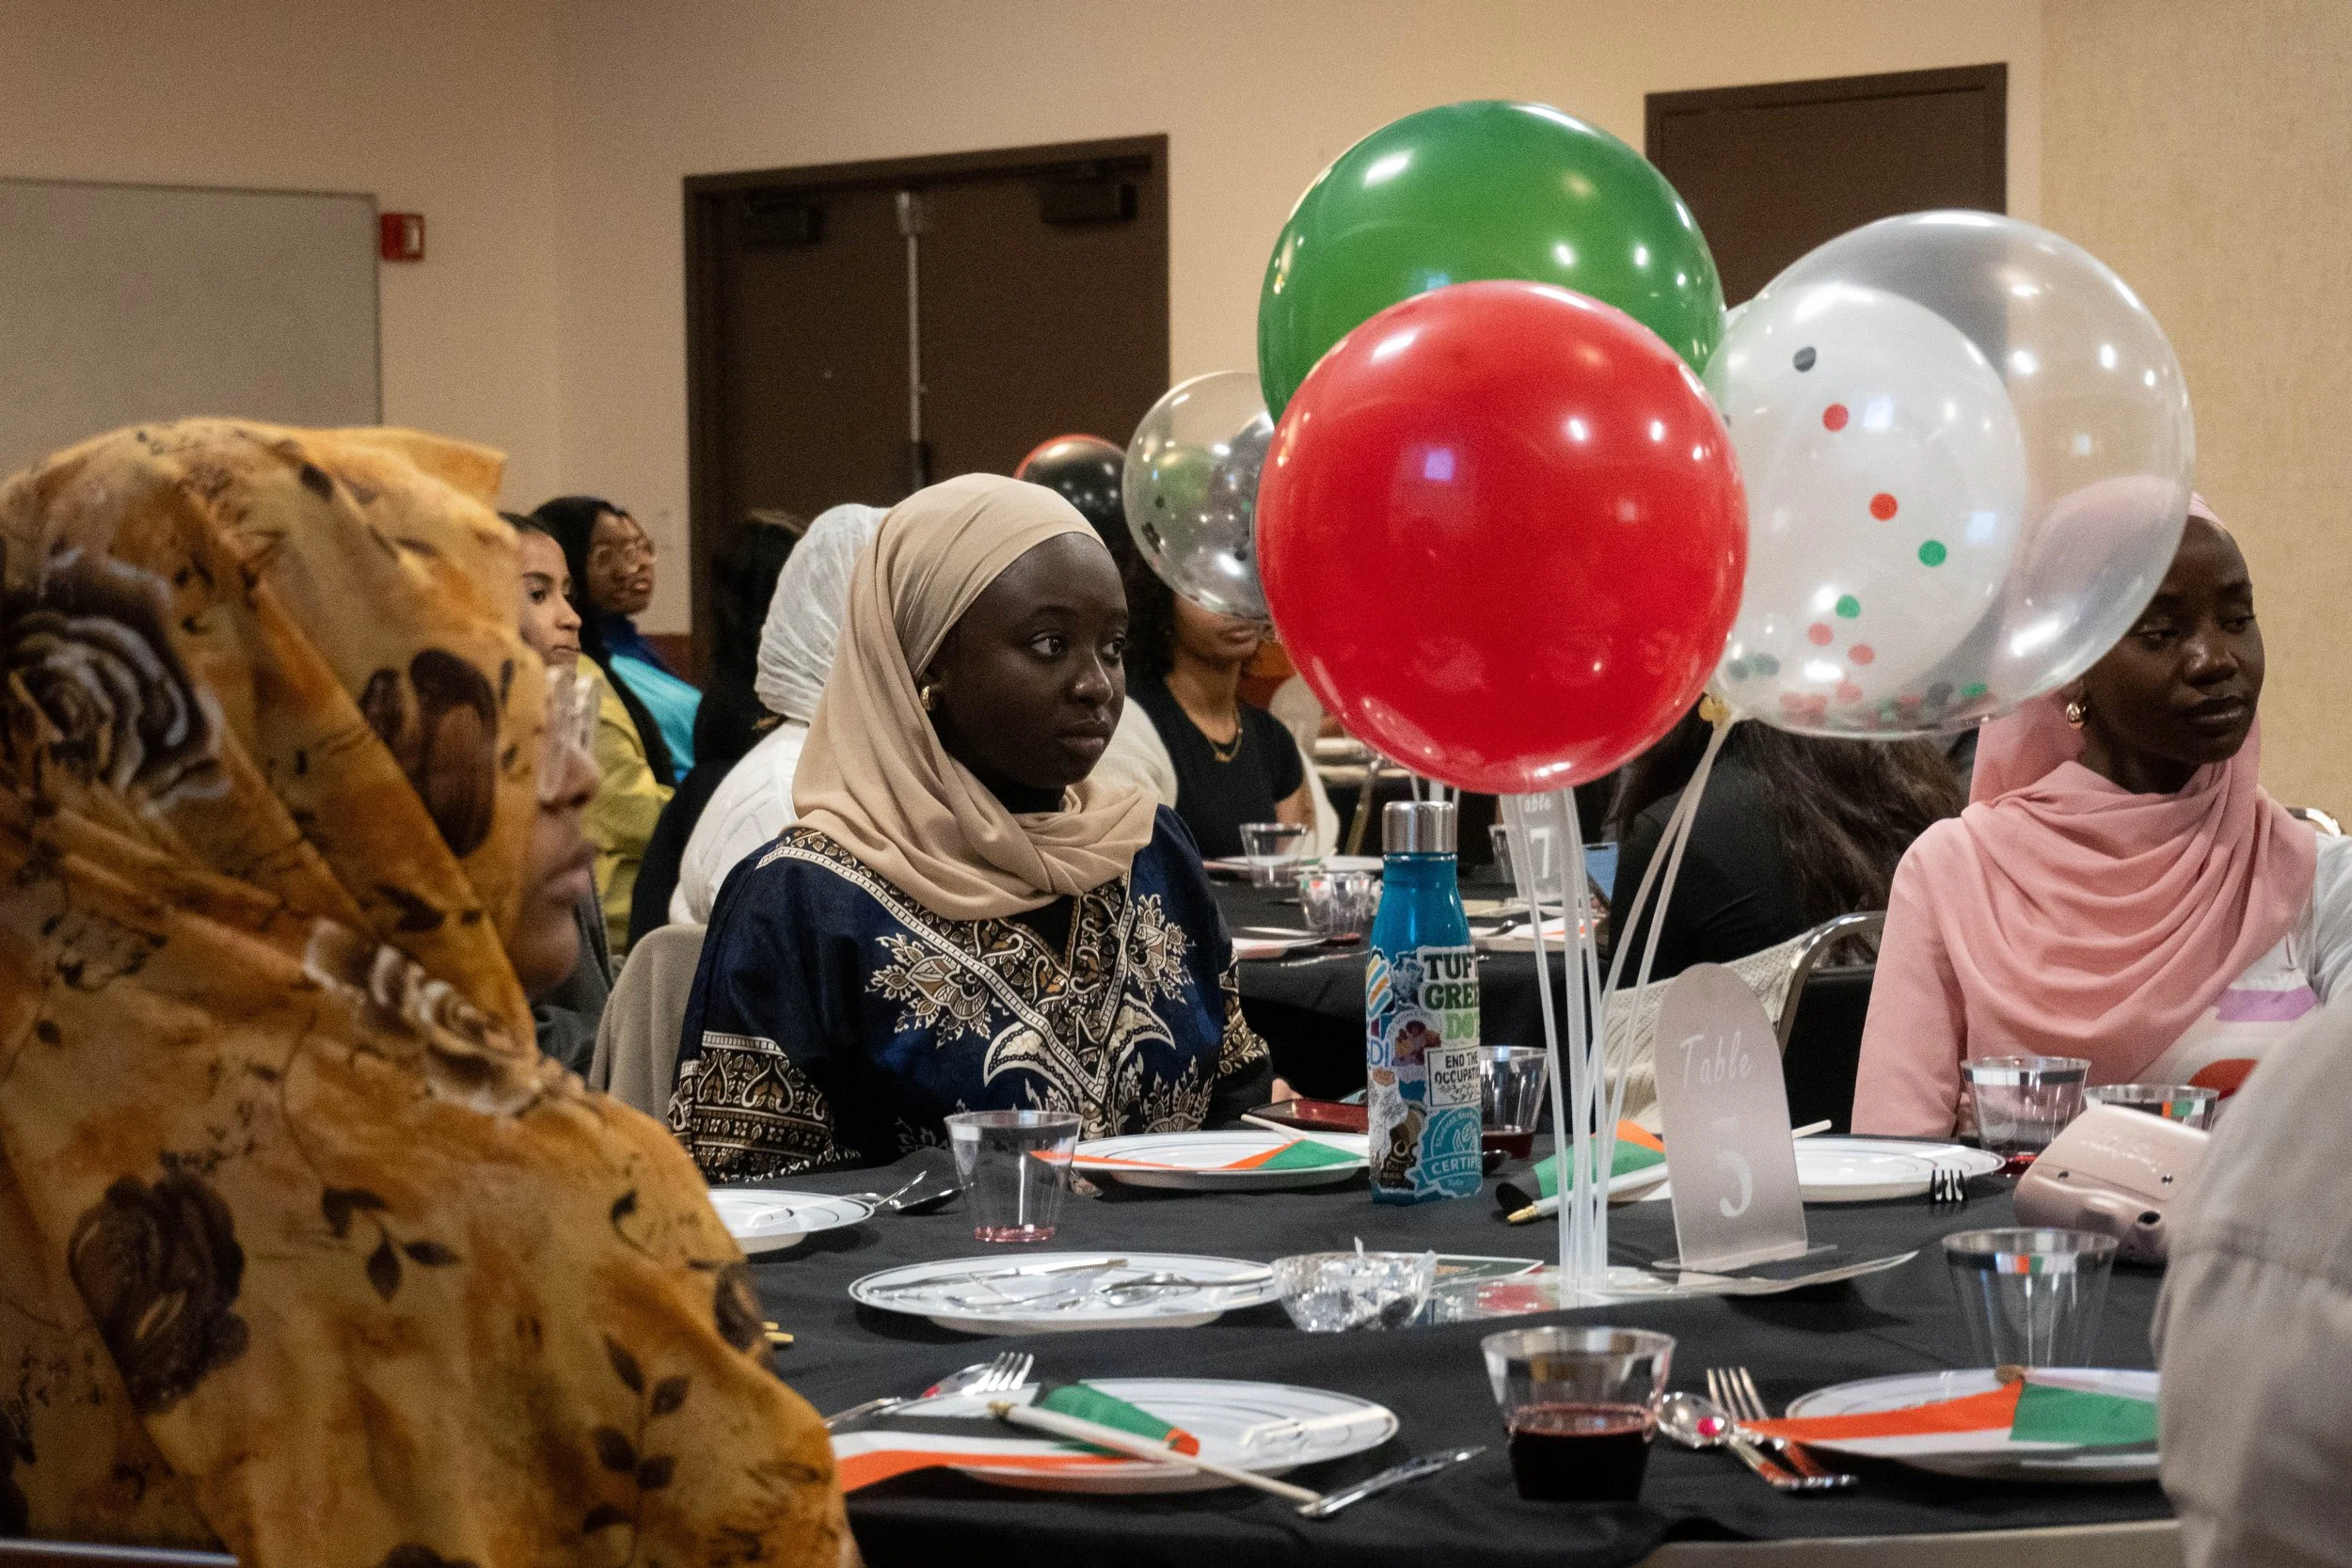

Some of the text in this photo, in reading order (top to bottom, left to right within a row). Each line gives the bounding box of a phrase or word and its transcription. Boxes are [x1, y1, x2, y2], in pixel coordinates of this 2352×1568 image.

[1523, 792, 1552, 814] able
[1529, 828, 1550, 879] 7
[1445, 1051, 1478, 1069] END THE
[1679, 1030, 1752, 1089] Table
[1710, 1116, 1754, 1218] 5
